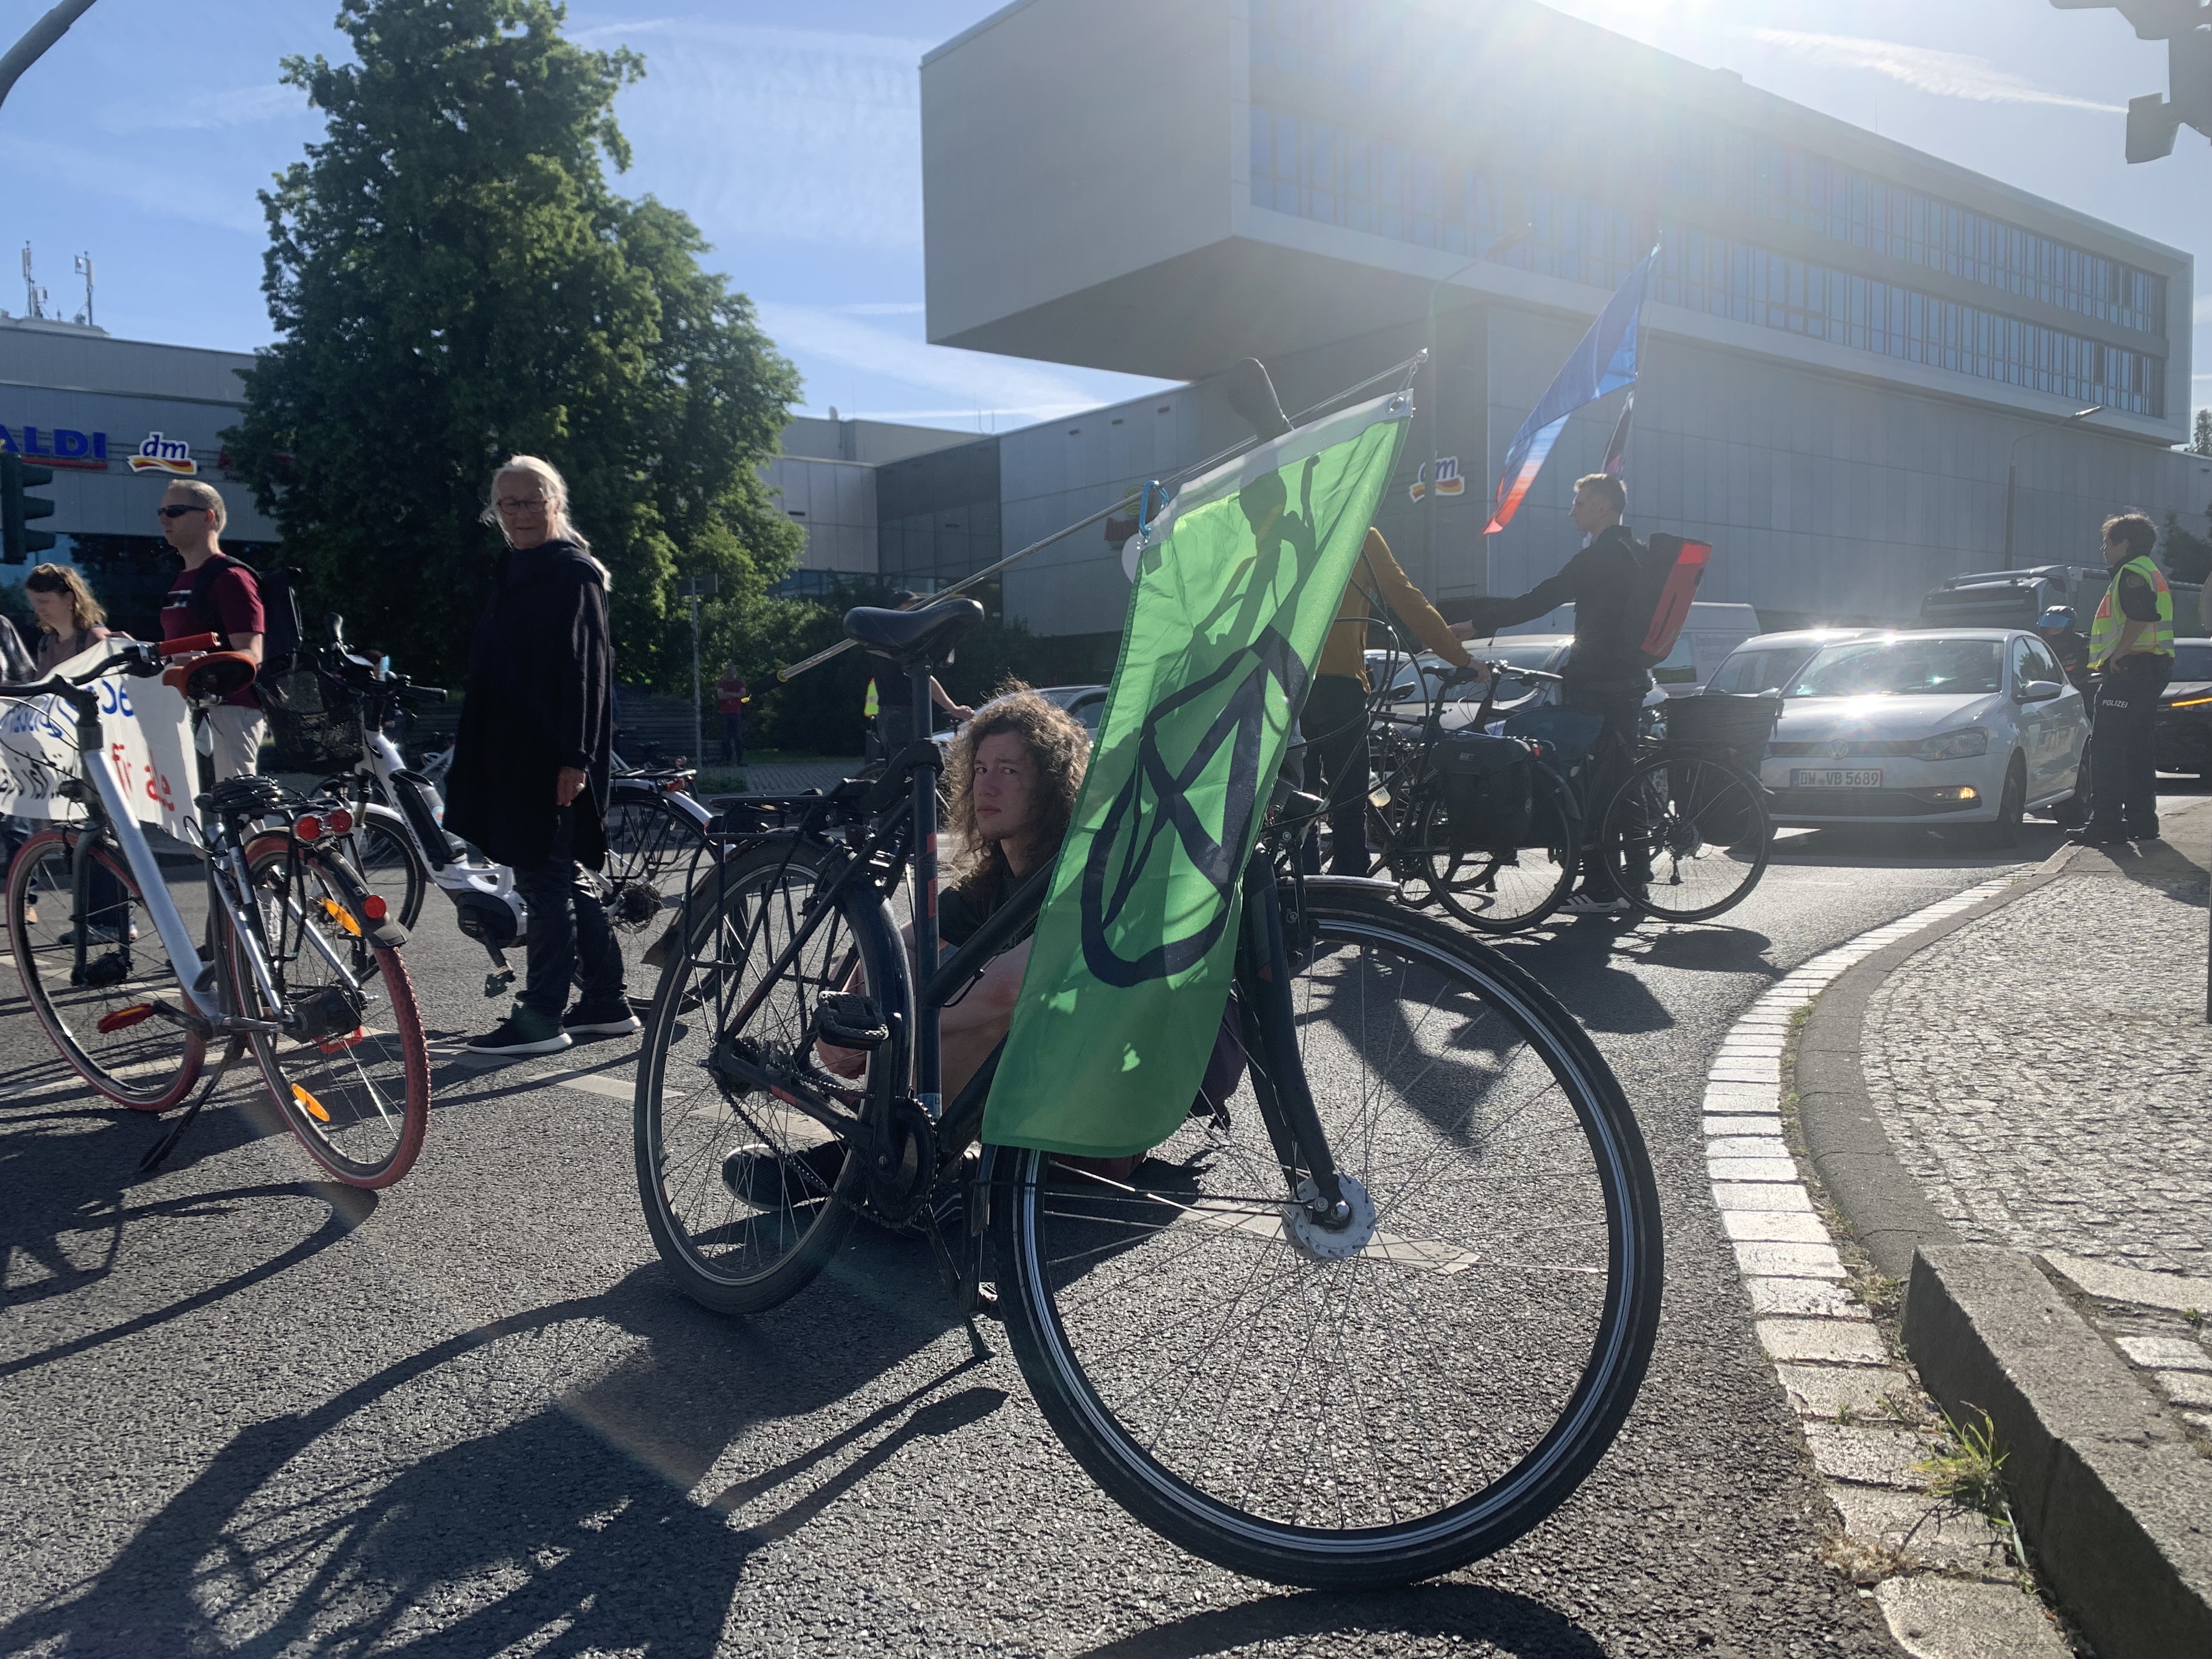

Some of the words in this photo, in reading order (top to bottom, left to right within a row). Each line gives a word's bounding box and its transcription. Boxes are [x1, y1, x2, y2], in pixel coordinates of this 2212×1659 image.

[143, 434, 186, 459] dm
[2102, 699, 2128, 708] POLIZEI
[1800, 772, 1816, 785] DW
[1826, 772, 1842, 785] VB
[1846, 772, 1879, 785] 5689
